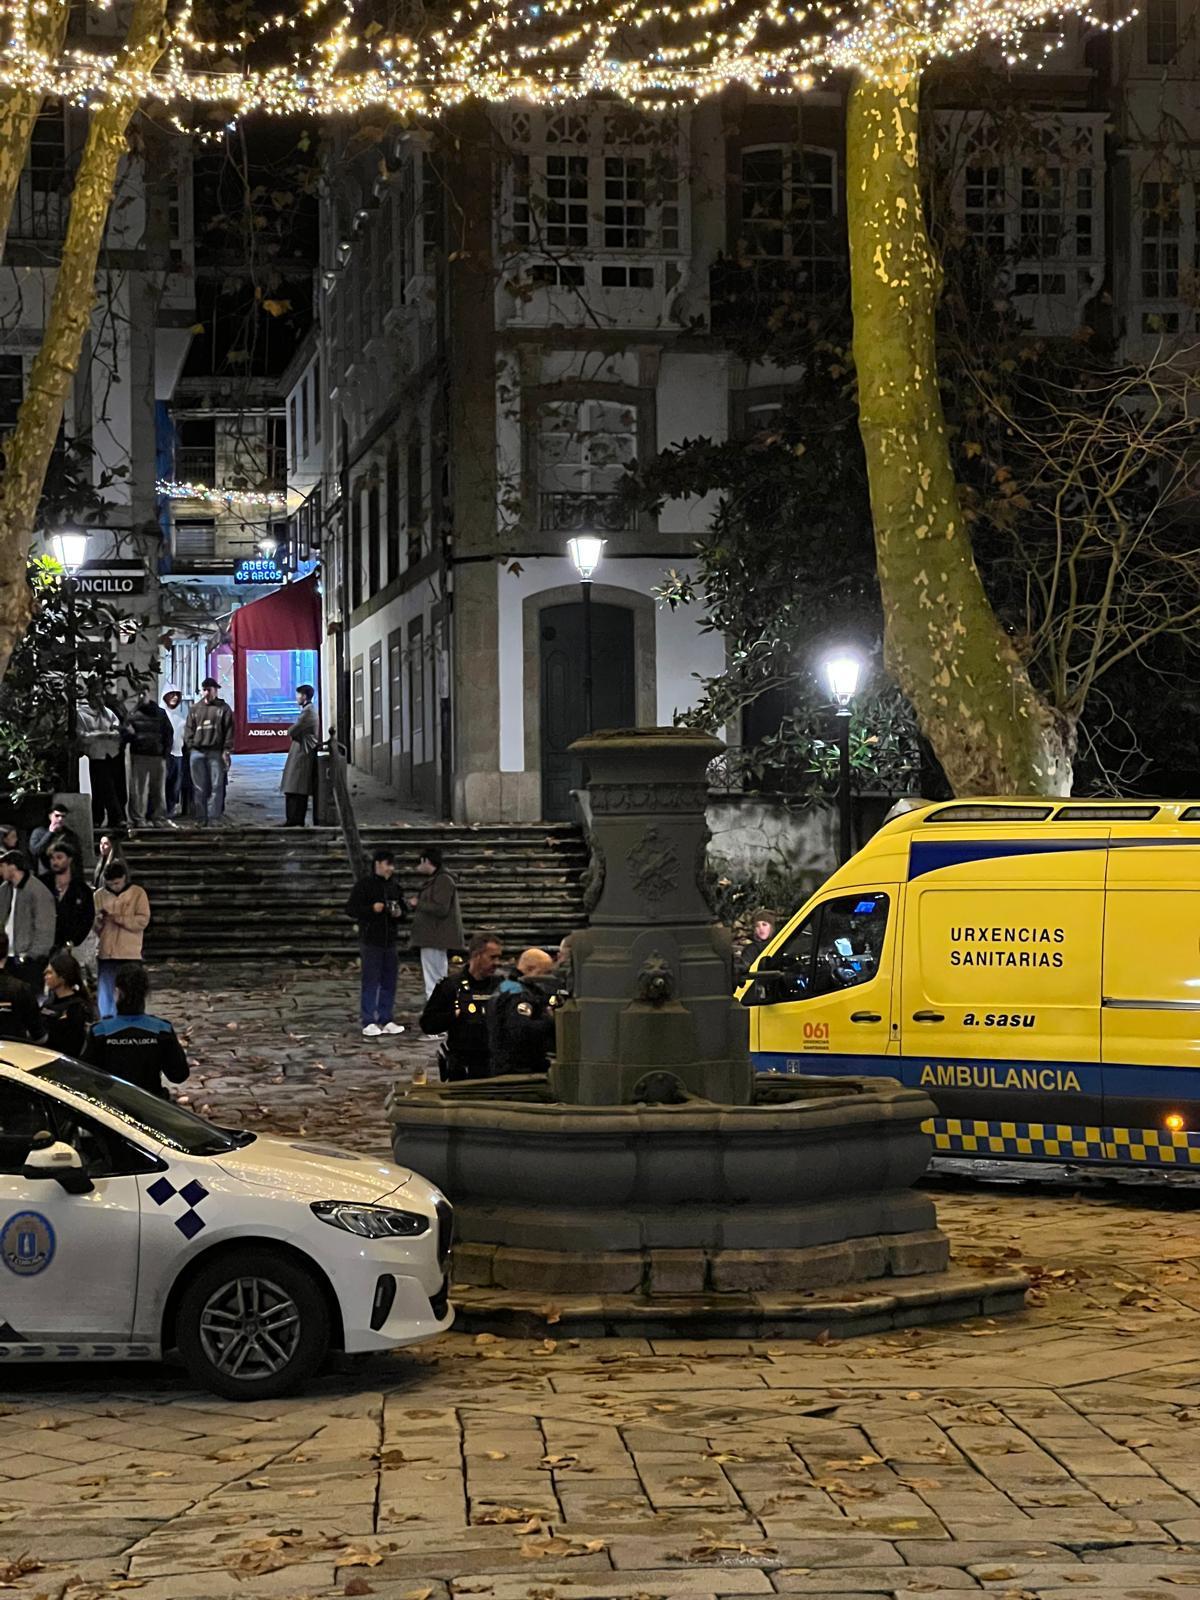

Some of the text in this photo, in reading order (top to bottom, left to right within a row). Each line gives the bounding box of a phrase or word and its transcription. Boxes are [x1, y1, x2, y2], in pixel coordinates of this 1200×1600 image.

[242, 561, 275, 570] ADEGA
[236, 571, 282, 580] OS ARCOS
[951, 927, 1064, 943] URXENCIAS
[950, 951, 1064, 967] SANITARIAS
[803, 1022, 829, 1038] 061
[920, 1065, 1082, 1092] AMBULANCIA
